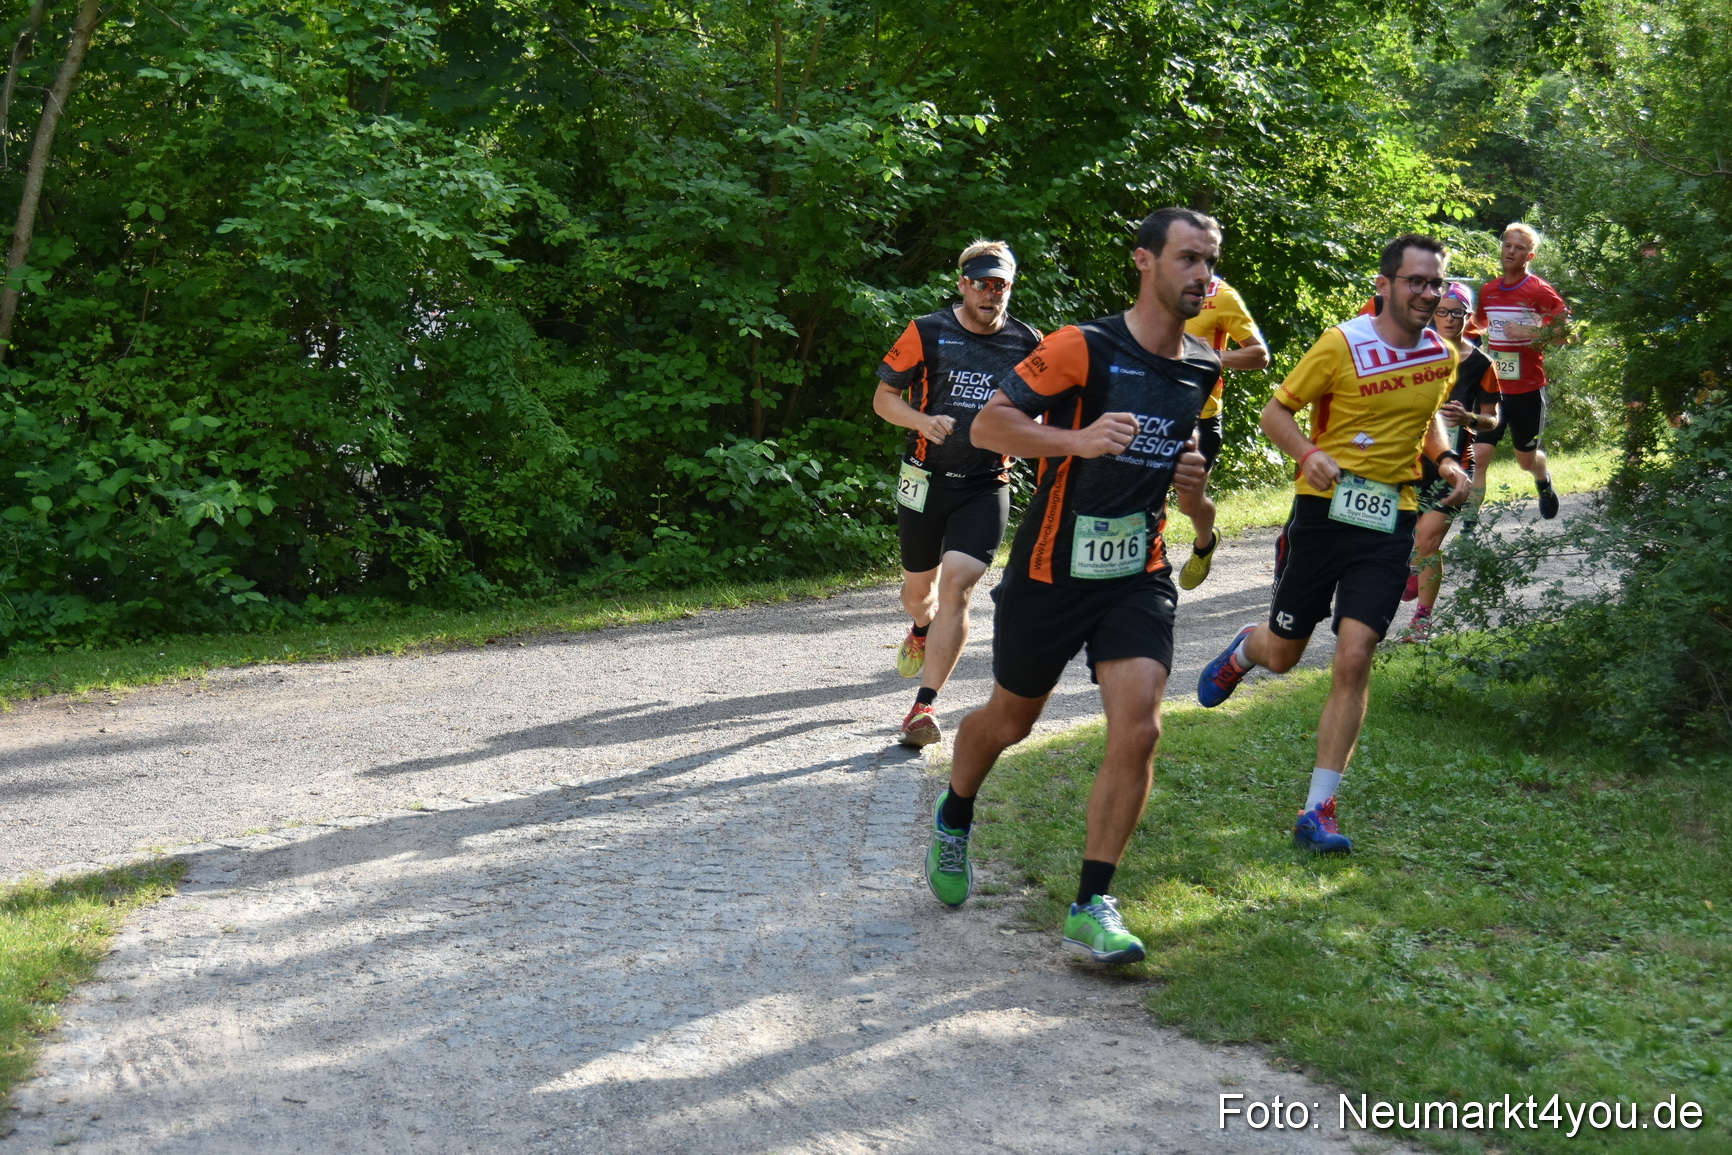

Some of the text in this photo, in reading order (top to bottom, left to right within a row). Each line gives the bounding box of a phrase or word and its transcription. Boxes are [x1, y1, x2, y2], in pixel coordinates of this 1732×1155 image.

[948, 370, 993, 387] HECK
[1359, 376, 1406, 398] MAX
[1132, 414, 1175, 436] ECK
[1128, 434, 1184, 457] ESIG
[1343, 489, 1392, 517] 1685
[1362, 512, 1382, 521] Dominik
[1085, 535, 1138, 562] 1016
[1078, 561, 1117, 569] Hundsdorfer
[1276, 610, 1294, 631] 42
